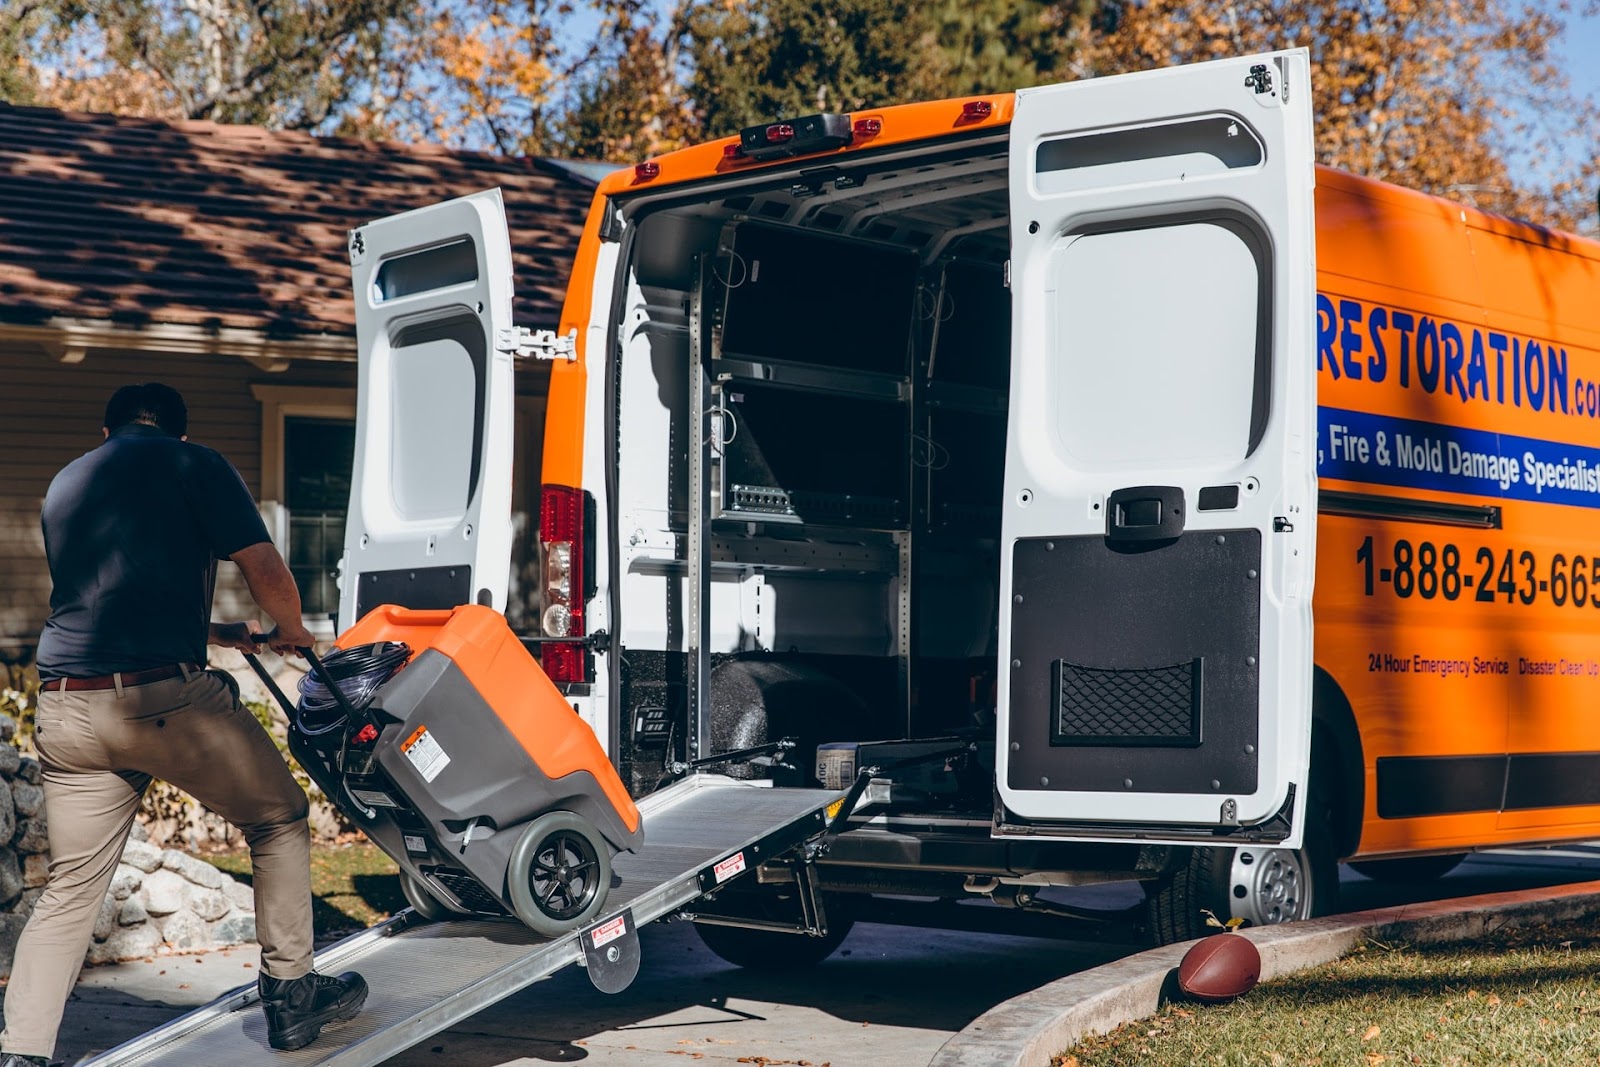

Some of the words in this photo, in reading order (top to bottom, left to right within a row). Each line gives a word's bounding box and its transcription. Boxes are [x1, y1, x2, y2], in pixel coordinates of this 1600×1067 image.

[1317, 293, 1600, 419] RESTORATION.co
[1329, 424, 1370, 464] Fire
[1376, 430, 1391, 467] &
[1396, 434, 1443, 473] Mold
[1447, 441, 1520, 490] Damage
[1368, 653, 1382, 672] 24
[1384, 654, 1411, 673] Hour
[1414, 655, 1470, 678] Emergency
[1473, 656, 1509, 674] Service
[1519, 657, 1556, 675] Disaster
[1560, 658, 1583, 675] Clean
[1587, 658, 1599, 679] Up
